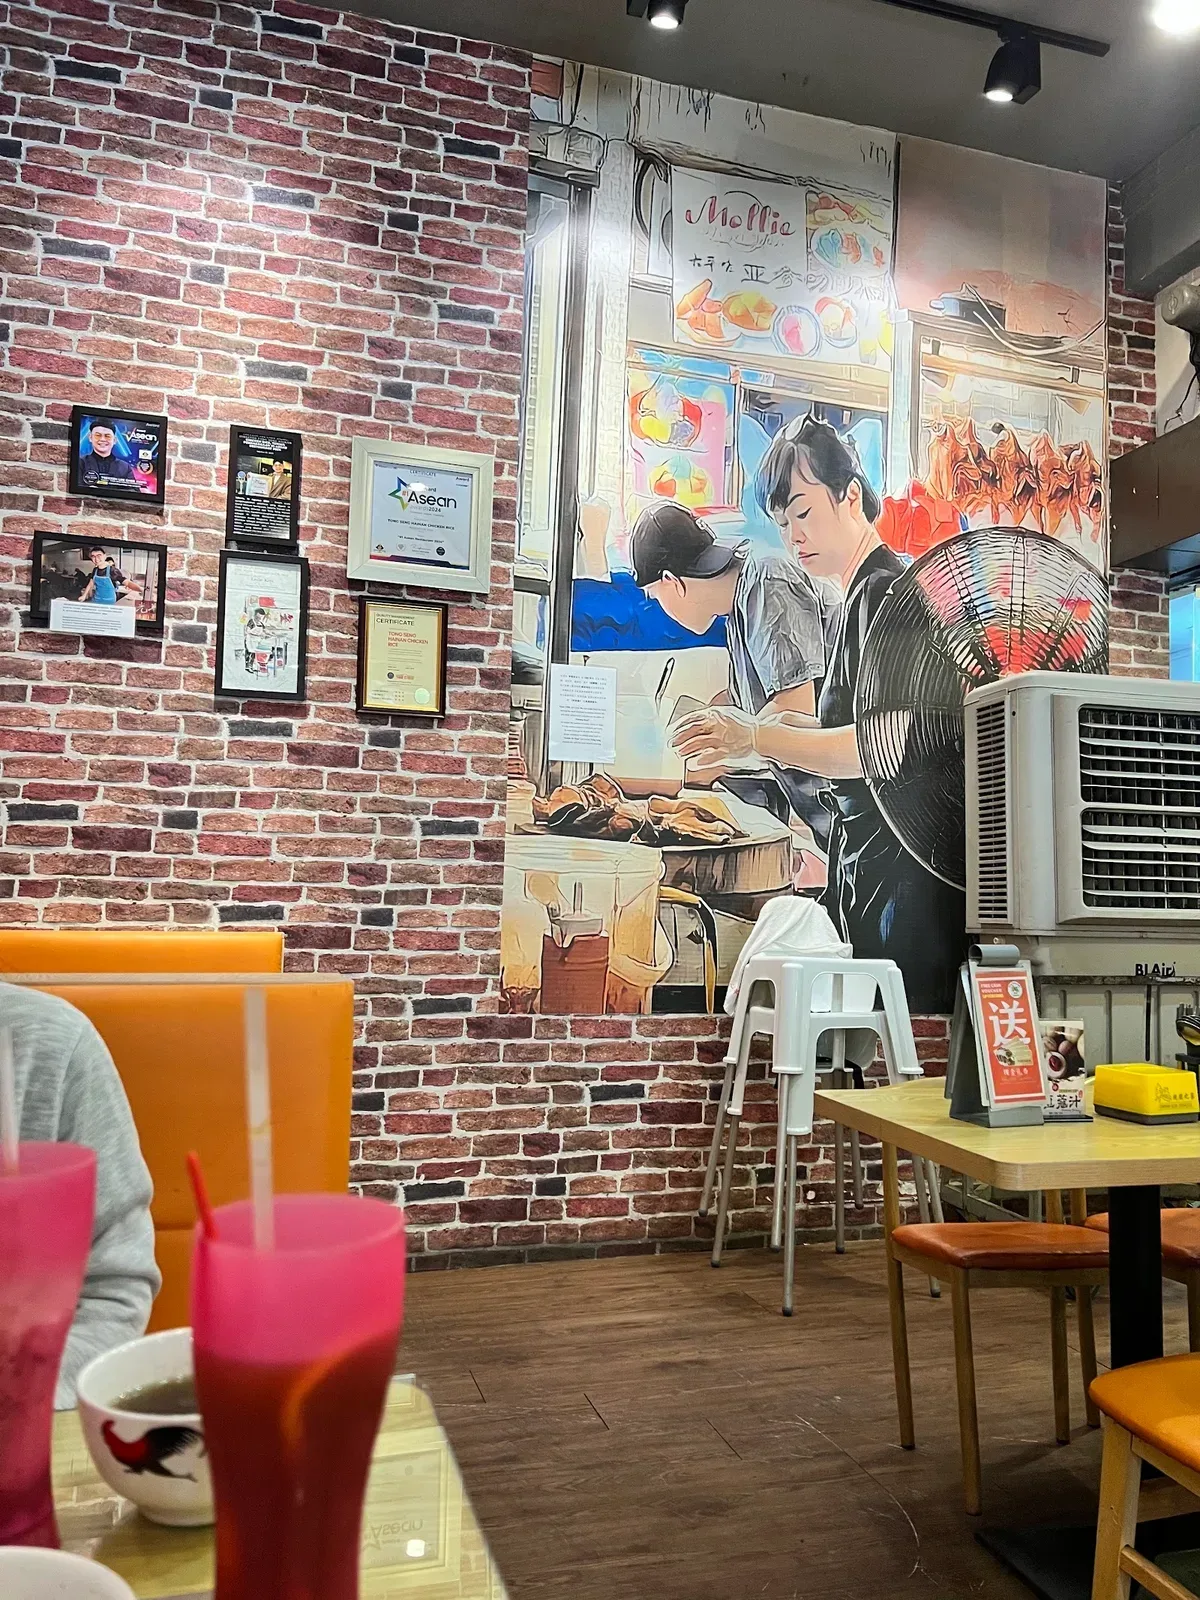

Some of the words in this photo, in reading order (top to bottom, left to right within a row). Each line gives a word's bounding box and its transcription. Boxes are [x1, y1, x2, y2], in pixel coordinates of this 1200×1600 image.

[684, 195, 796, 236] Mollie
[130, 430, 157, 442] Asean
[407, 490, 457, 509] Asean
[376, 617, 415, 626] CERTIFICATE
[988, 999, 1031, 1047] 送
